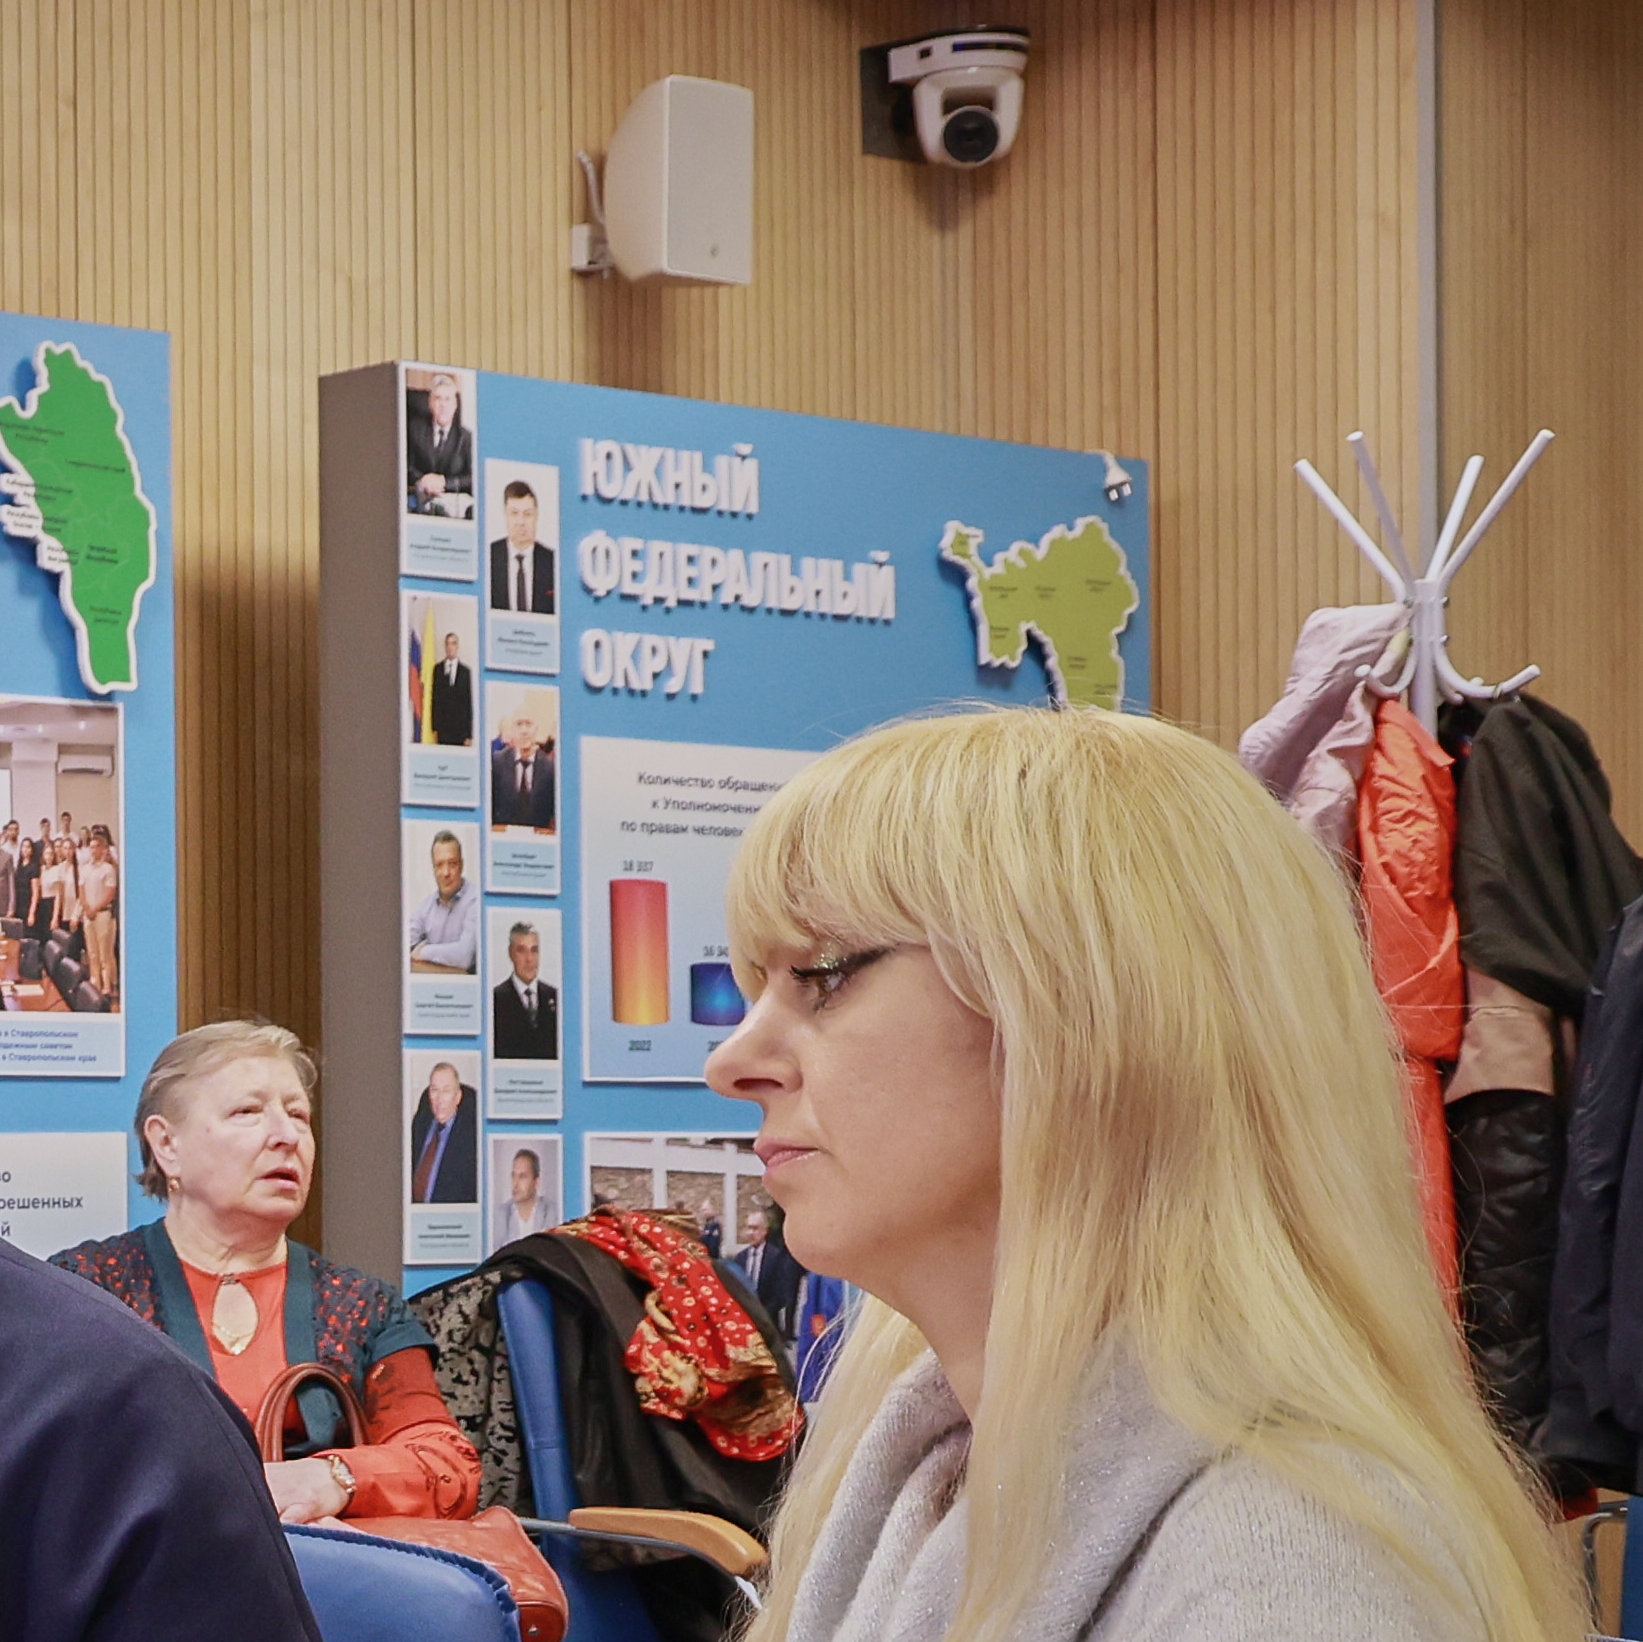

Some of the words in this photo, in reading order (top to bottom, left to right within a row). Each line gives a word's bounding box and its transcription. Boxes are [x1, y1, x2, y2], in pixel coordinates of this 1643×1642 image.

[580, 438, 759, 516] ЮЖНЫЙ
[579, 530, 897, 622] ФЕДЕРАЛЬНЫЙ
[581, 628, 714, 695] ОКРУГ
[638, 772, 714, 788] Количество
[620, 821, 637, 832] по
[640, 821, 689, 835] правам
